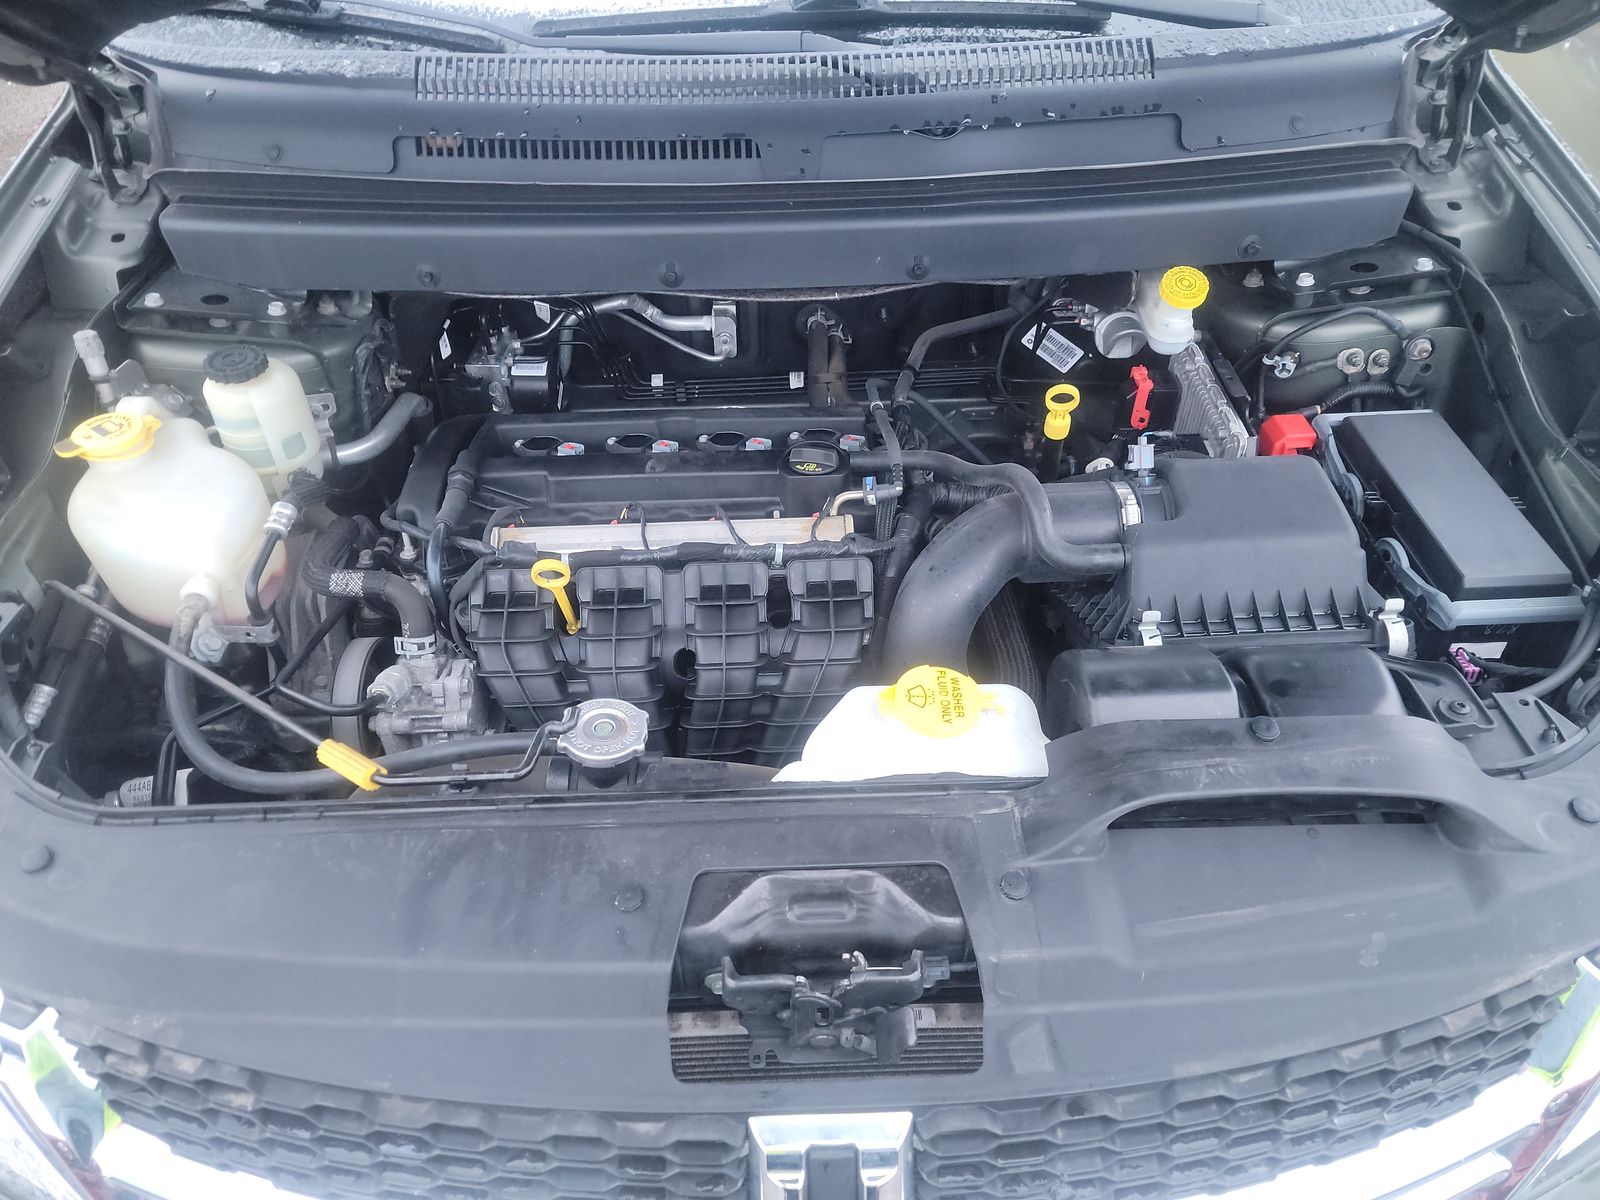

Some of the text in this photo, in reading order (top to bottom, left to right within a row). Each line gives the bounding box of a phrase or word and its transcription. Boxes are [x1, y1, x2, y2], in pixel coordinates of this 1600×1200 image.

[937, 670, 953, 725] FLUID ONLY
[950, 677, 965, 718] WASHER
[571, 737, 592, 751] NOT
[593, 742, 625, 754] OPEN
[623, 730, 640, 745] HOT
